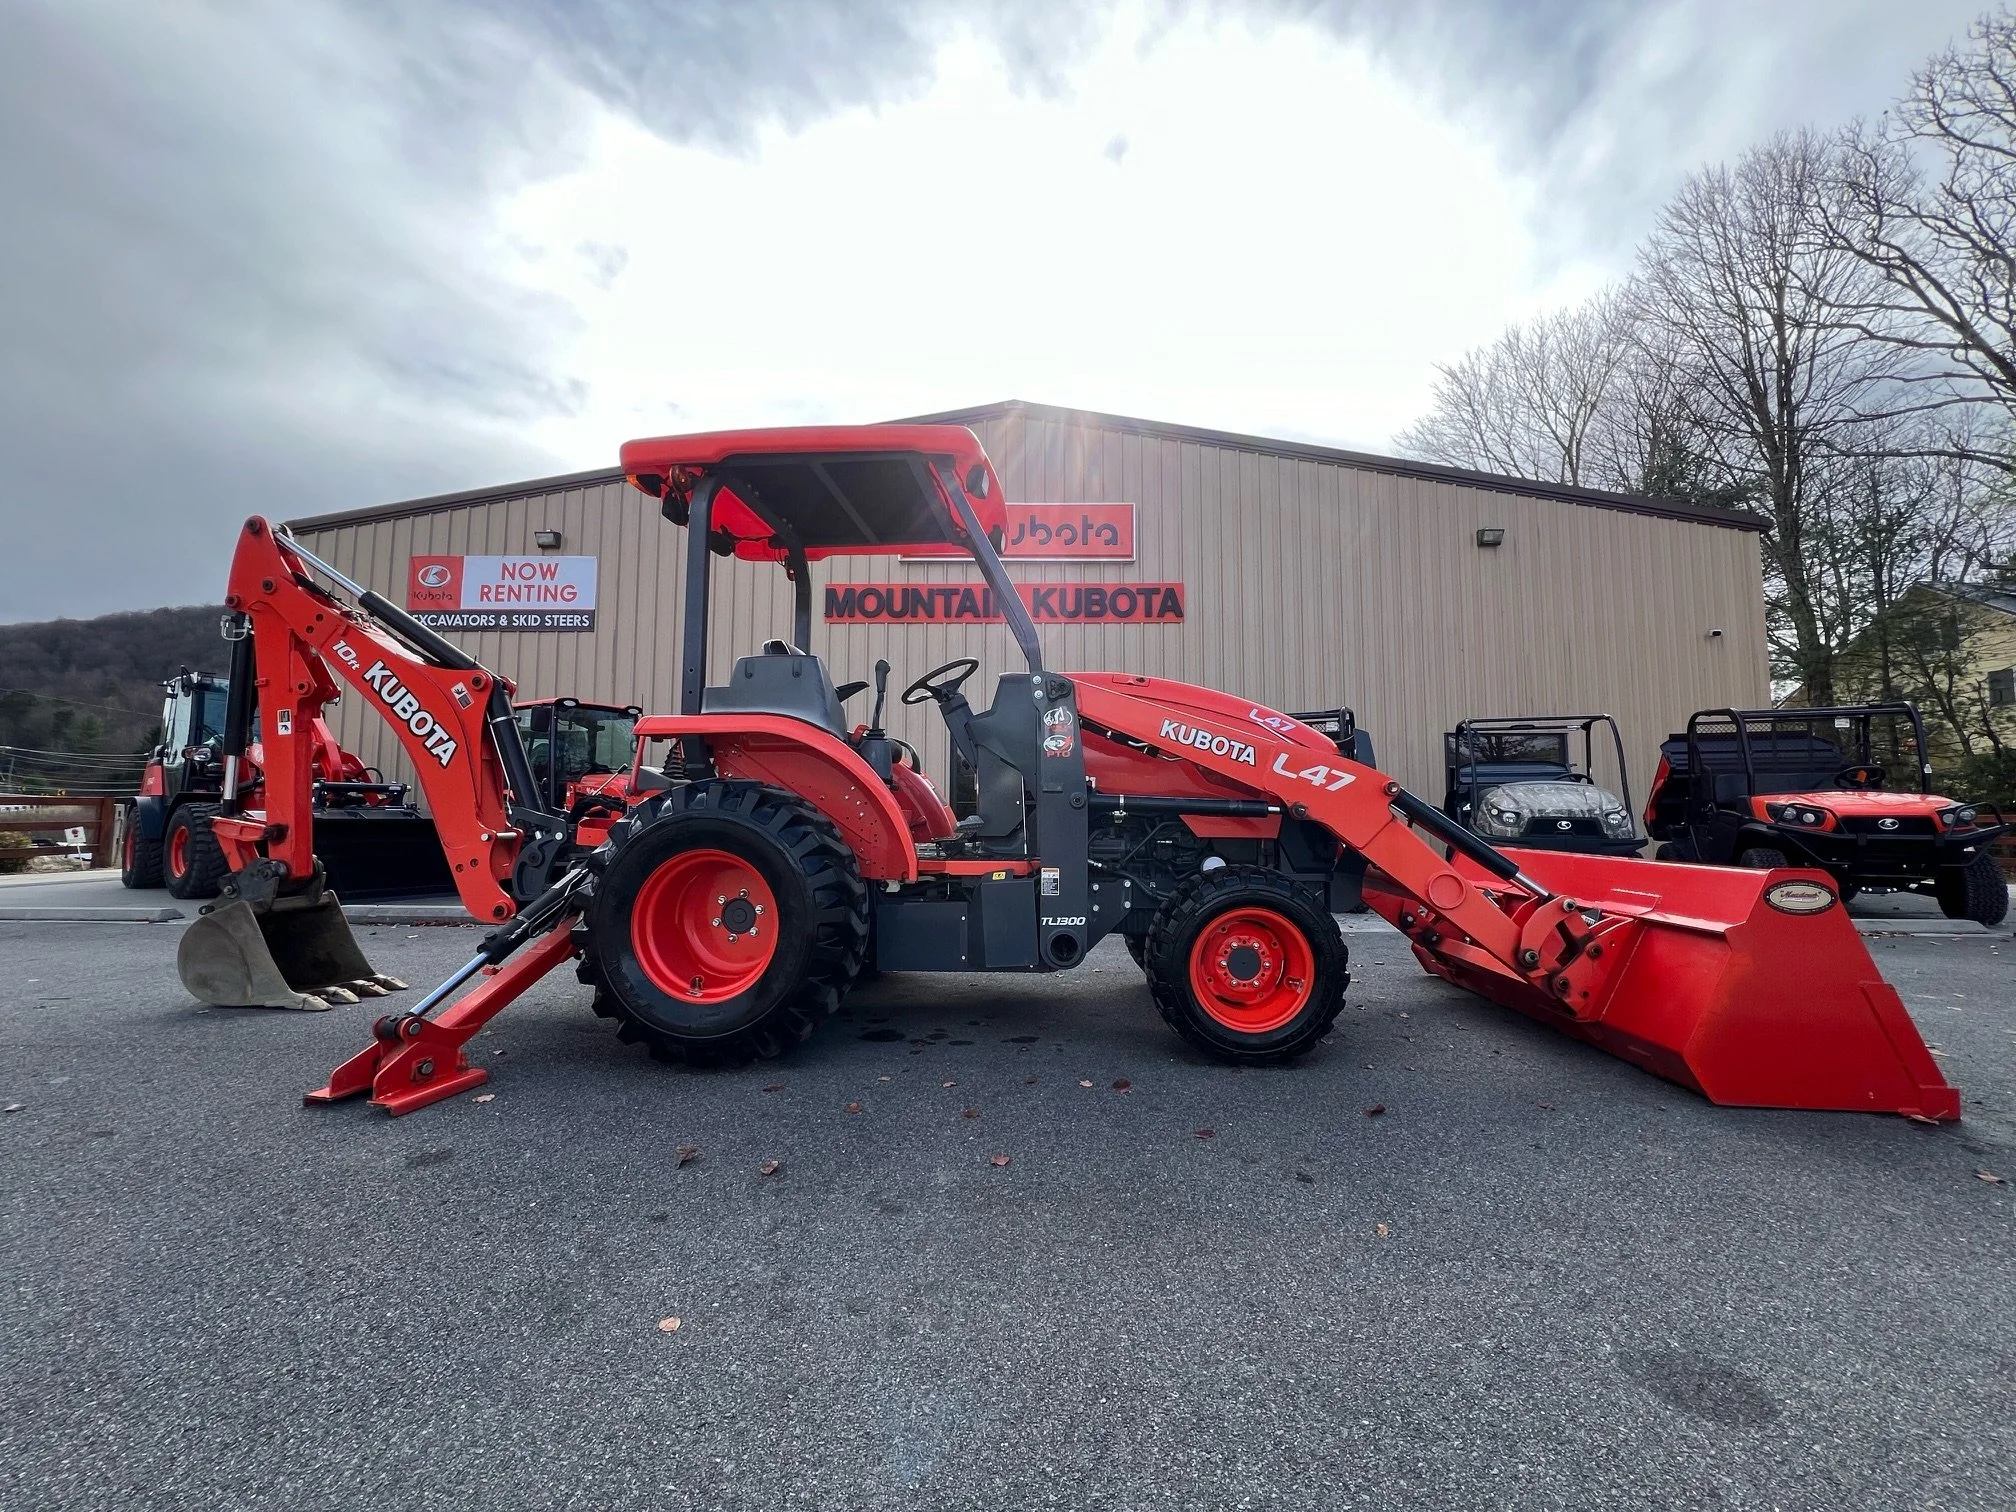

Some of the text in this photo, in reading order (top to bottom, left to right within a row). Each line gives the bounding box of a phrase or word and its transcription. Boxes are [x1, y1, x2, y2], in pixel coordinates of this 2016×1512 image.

[1011, 514, 1118, 546] ubota
[501, 562, 559, 581] NOW
[413, 591, 453, 601] Kubota
[479, 584, 578, 603] RENTING
[1032, 587, 1184, 618] KUBOTA
[500, 614, 509, 627] &
[512, 614, 541, 627] SKID
[544, 614, 590, 627] STEERS
[332, 640, 360, 671] 10ft
[363, 660, 457, 767] KUBOTA
[1249, 708, 1297, 732] L47
[1046, 750, 1071, 758] PTO
[1159, 718, 1257, 766] KUBOTA
[1272, 752, 1357, 792] L47
[1041, 916, 1087, 926] TL1300
